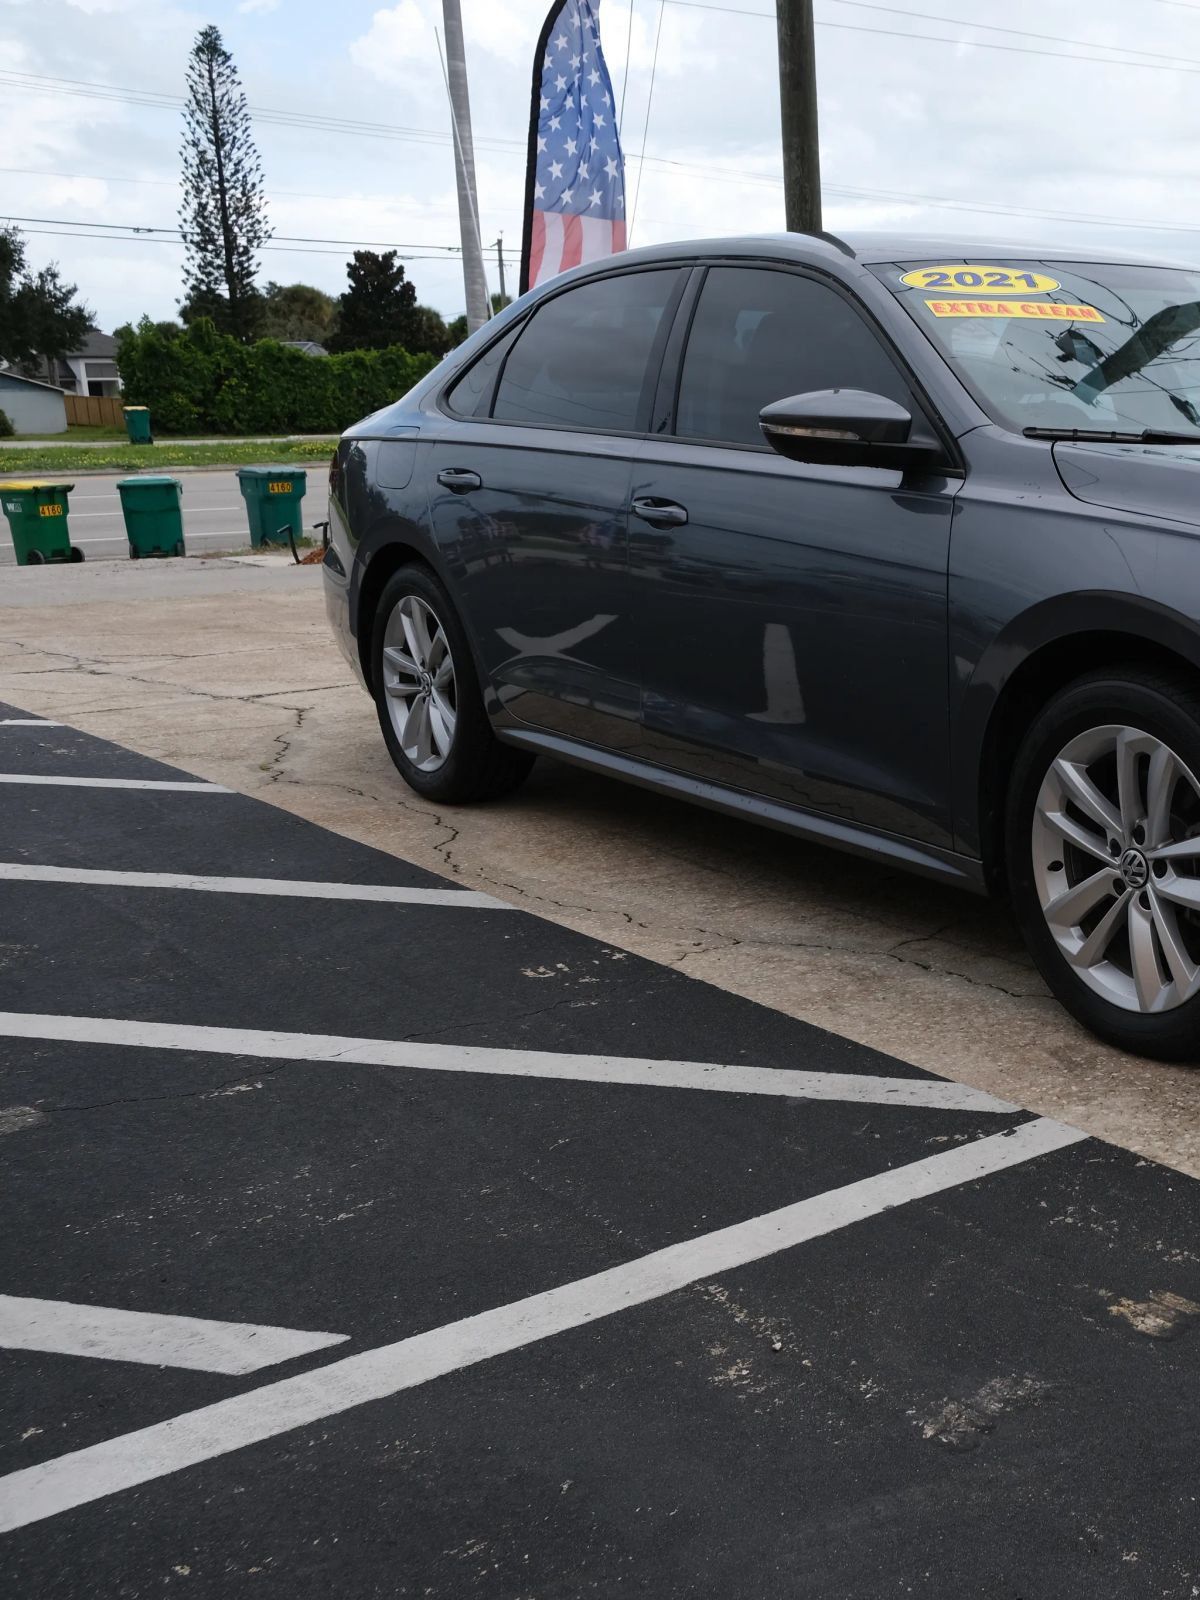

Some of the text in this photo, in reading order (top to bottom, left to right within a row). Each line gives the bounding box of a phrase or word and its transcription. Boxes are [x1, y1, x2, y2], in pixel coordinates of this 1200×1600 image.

[922, 271, 1039, 289] 2021
[931, 302, 1097, 321] EXTRA CLEAN
